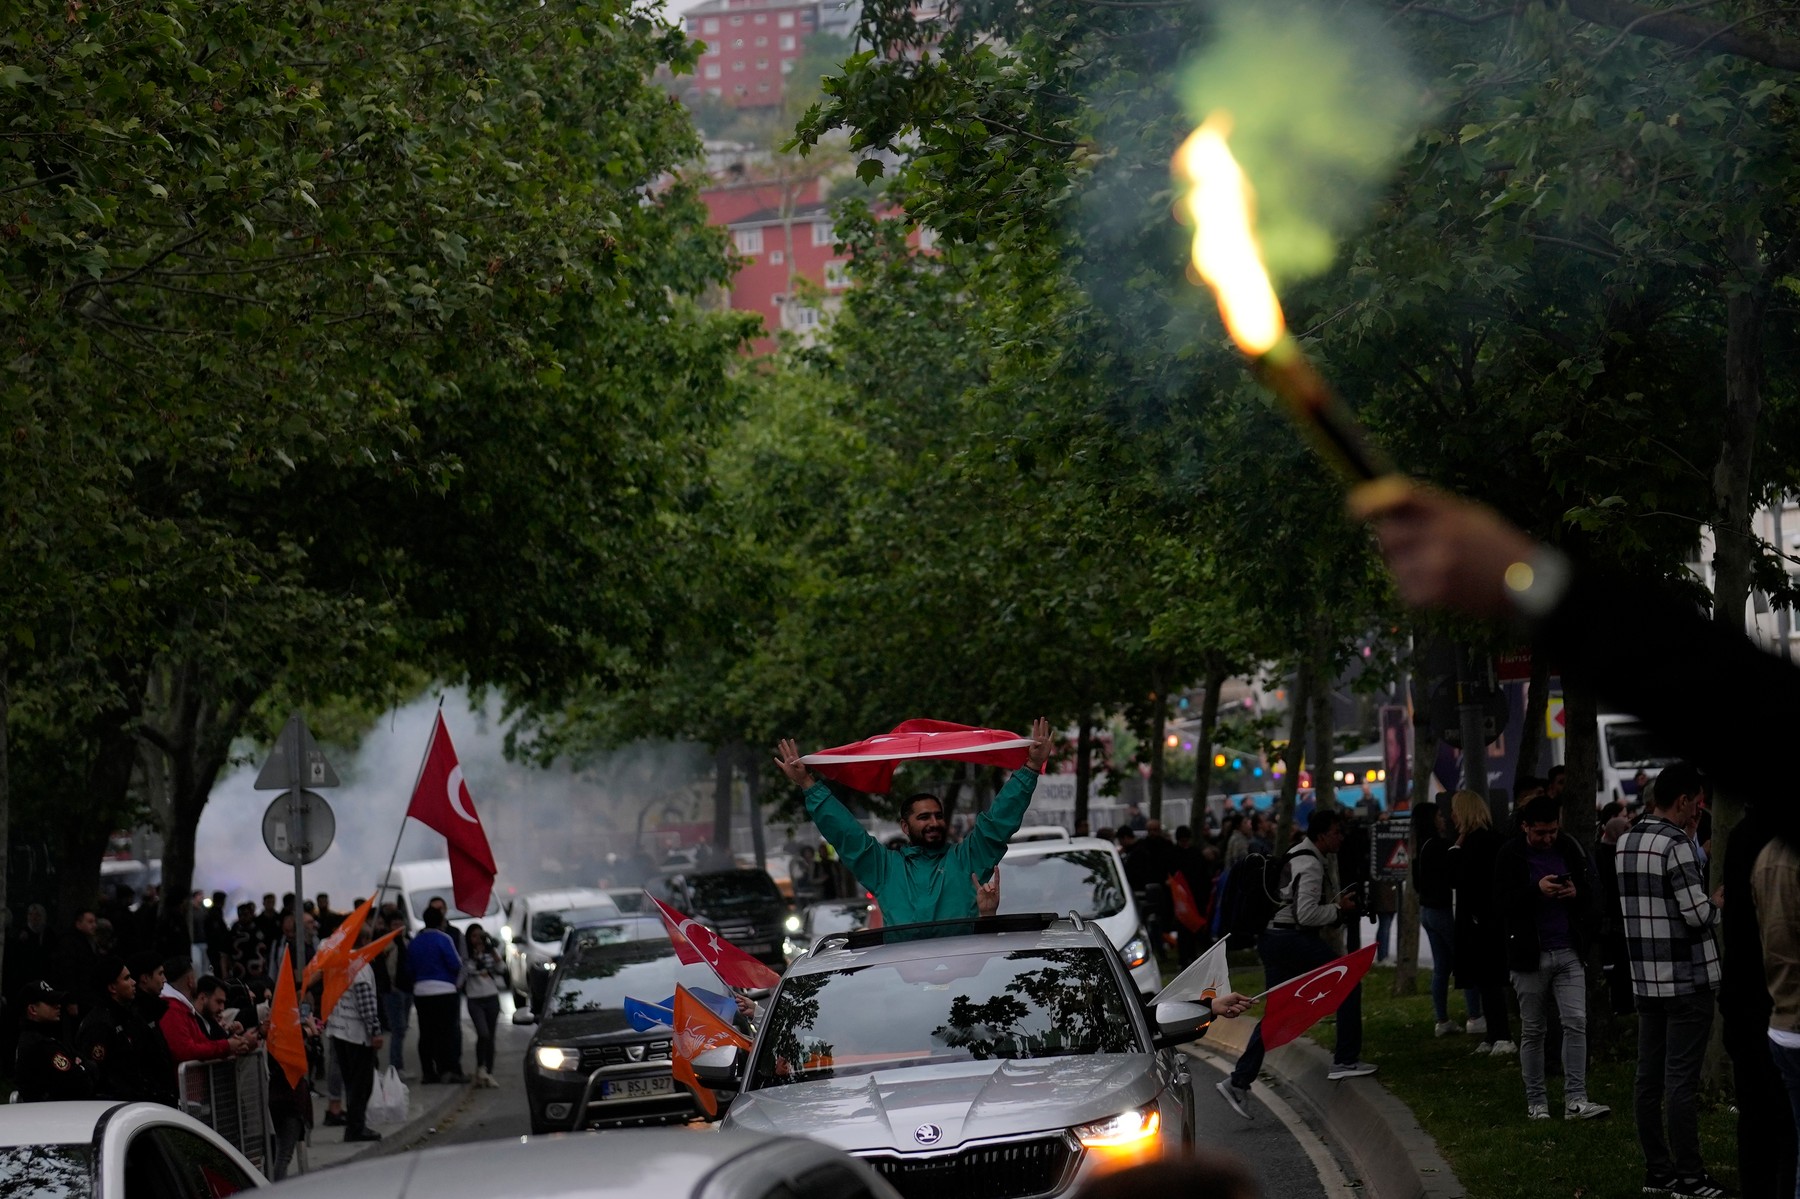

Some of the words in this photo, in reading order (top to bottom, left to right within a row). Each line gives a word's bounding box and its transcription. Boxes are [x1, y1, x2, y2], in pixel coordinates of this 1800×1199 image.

[609, 1082, 622, 1094] 34
[627, 1079, 648, 1093] BSJ
[652, 1077, 671, 1090] 927
